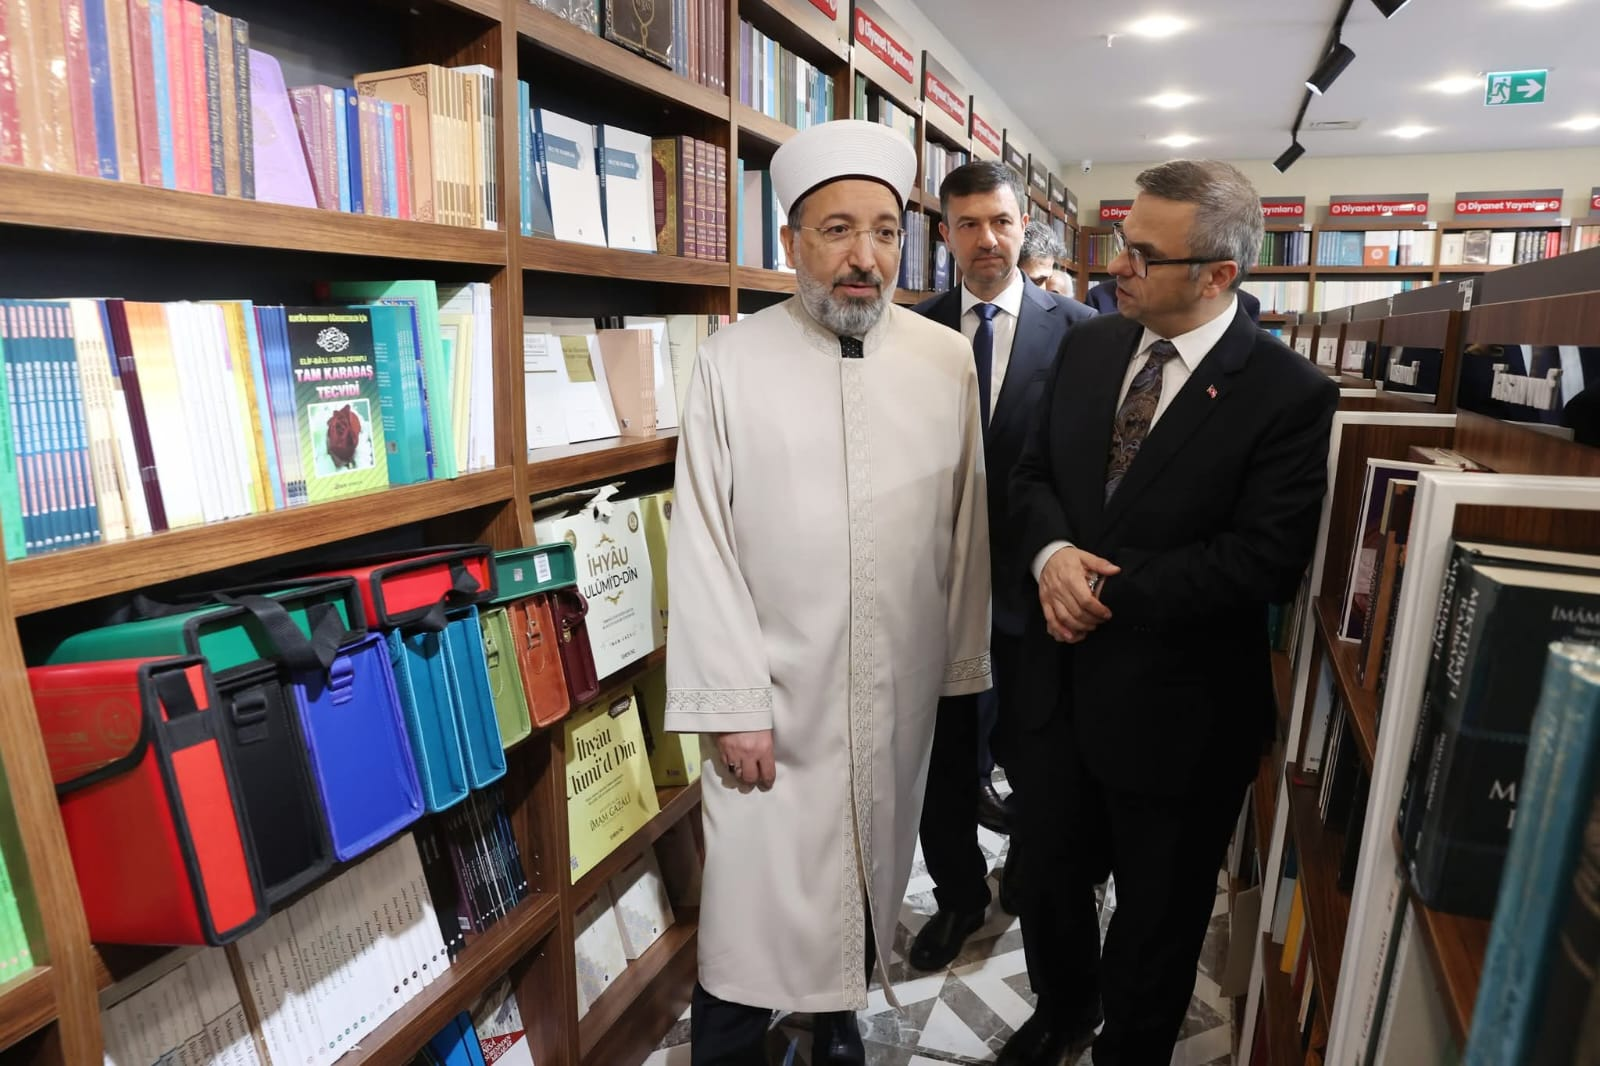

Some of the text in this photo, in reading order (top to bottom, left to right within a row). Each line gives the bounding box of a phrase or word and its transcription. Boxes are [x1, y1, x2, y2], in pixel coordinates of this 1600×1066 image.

[1110, 205, 1294, 218] Diya ayınları
[1341, 203, 1417, 215] Diyanet Yayını
[1468, 201, 1505, 213] Diyanet
[294, 368, 321, 382] TAM
[323, 364, 374, 380] KARABAŞ
[316, 380, 360, 399] TECVİDİ
[586, 545, 629, 577] İHYÂU
[576, 728, 612, 762] İhyâu
